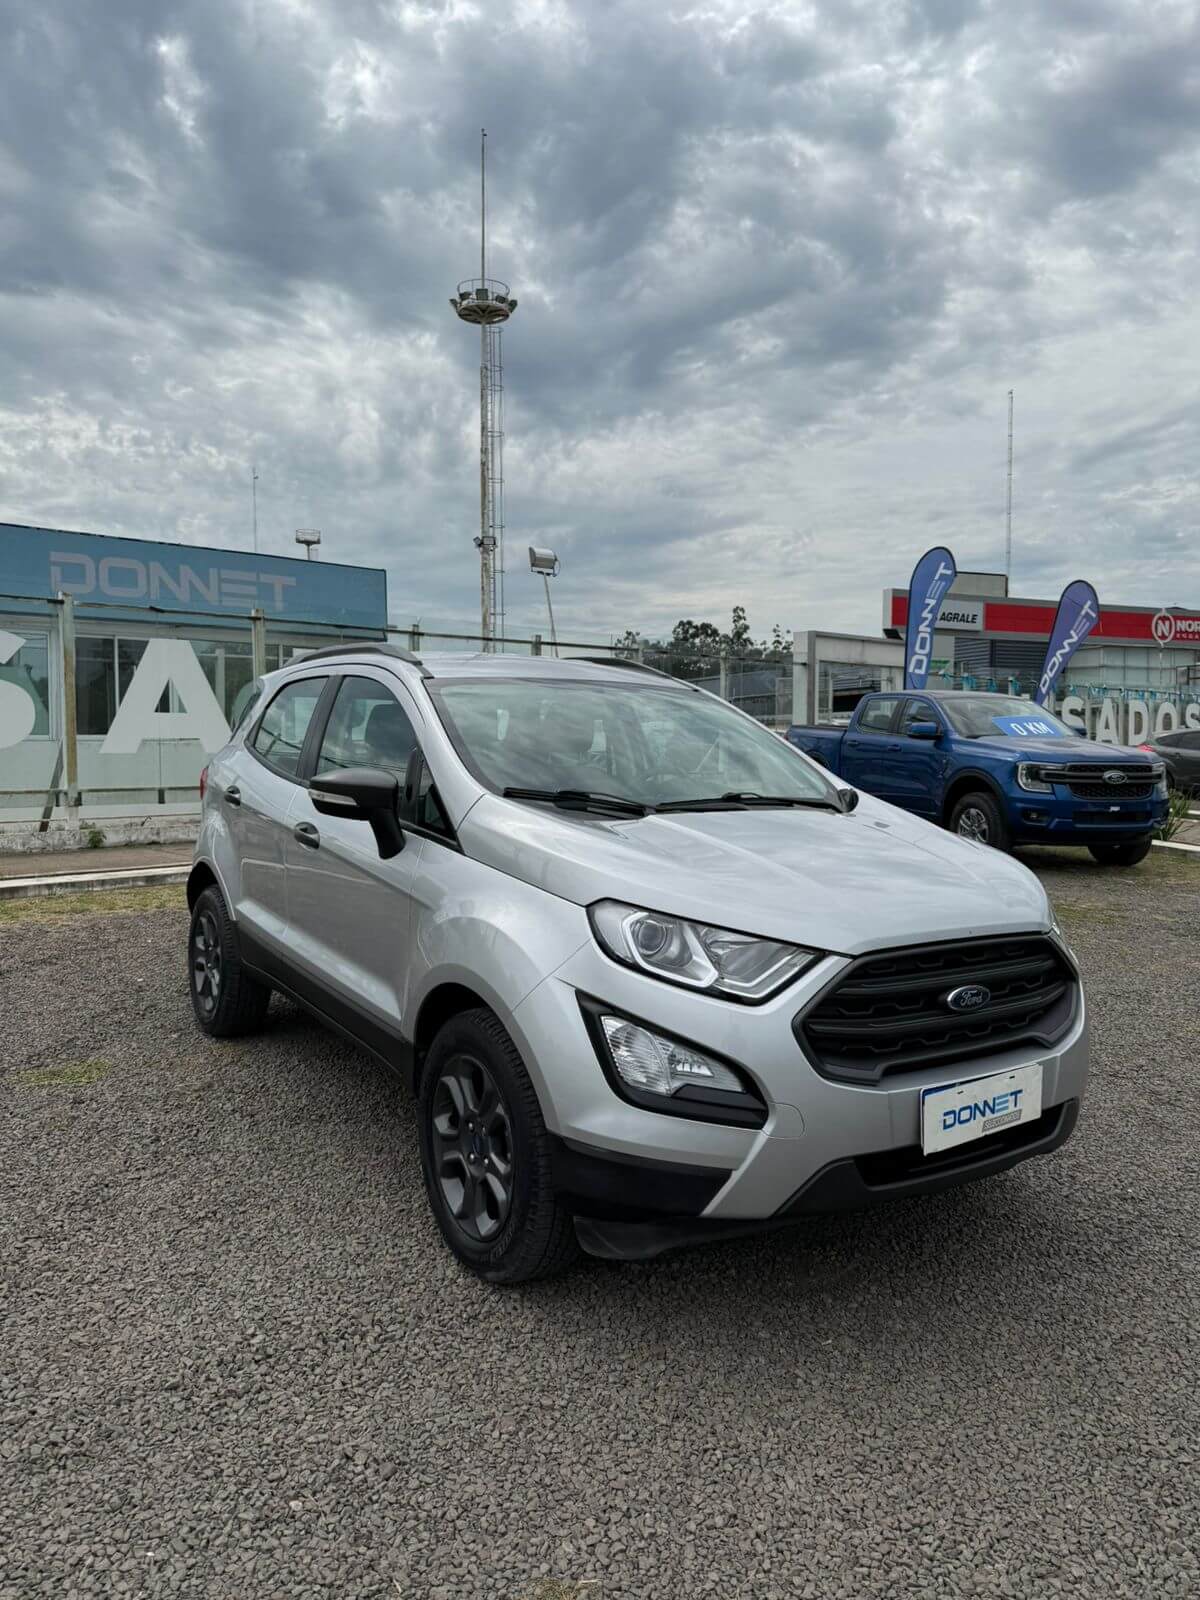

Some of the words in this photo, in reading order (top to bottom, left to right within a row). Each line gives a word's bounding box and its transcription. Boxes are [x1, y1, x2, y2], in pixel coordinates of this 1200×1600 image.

[50, 551, 297, 611] DONNET
[909, 562, 952, 675] DONNET
[940, 611, 978, 624] AGRALE
[1040, 600, 1096, 694] DONNET
[1023, 721, 1054, 735] KM
[943, 1089, 1023, 1130] DONNET
